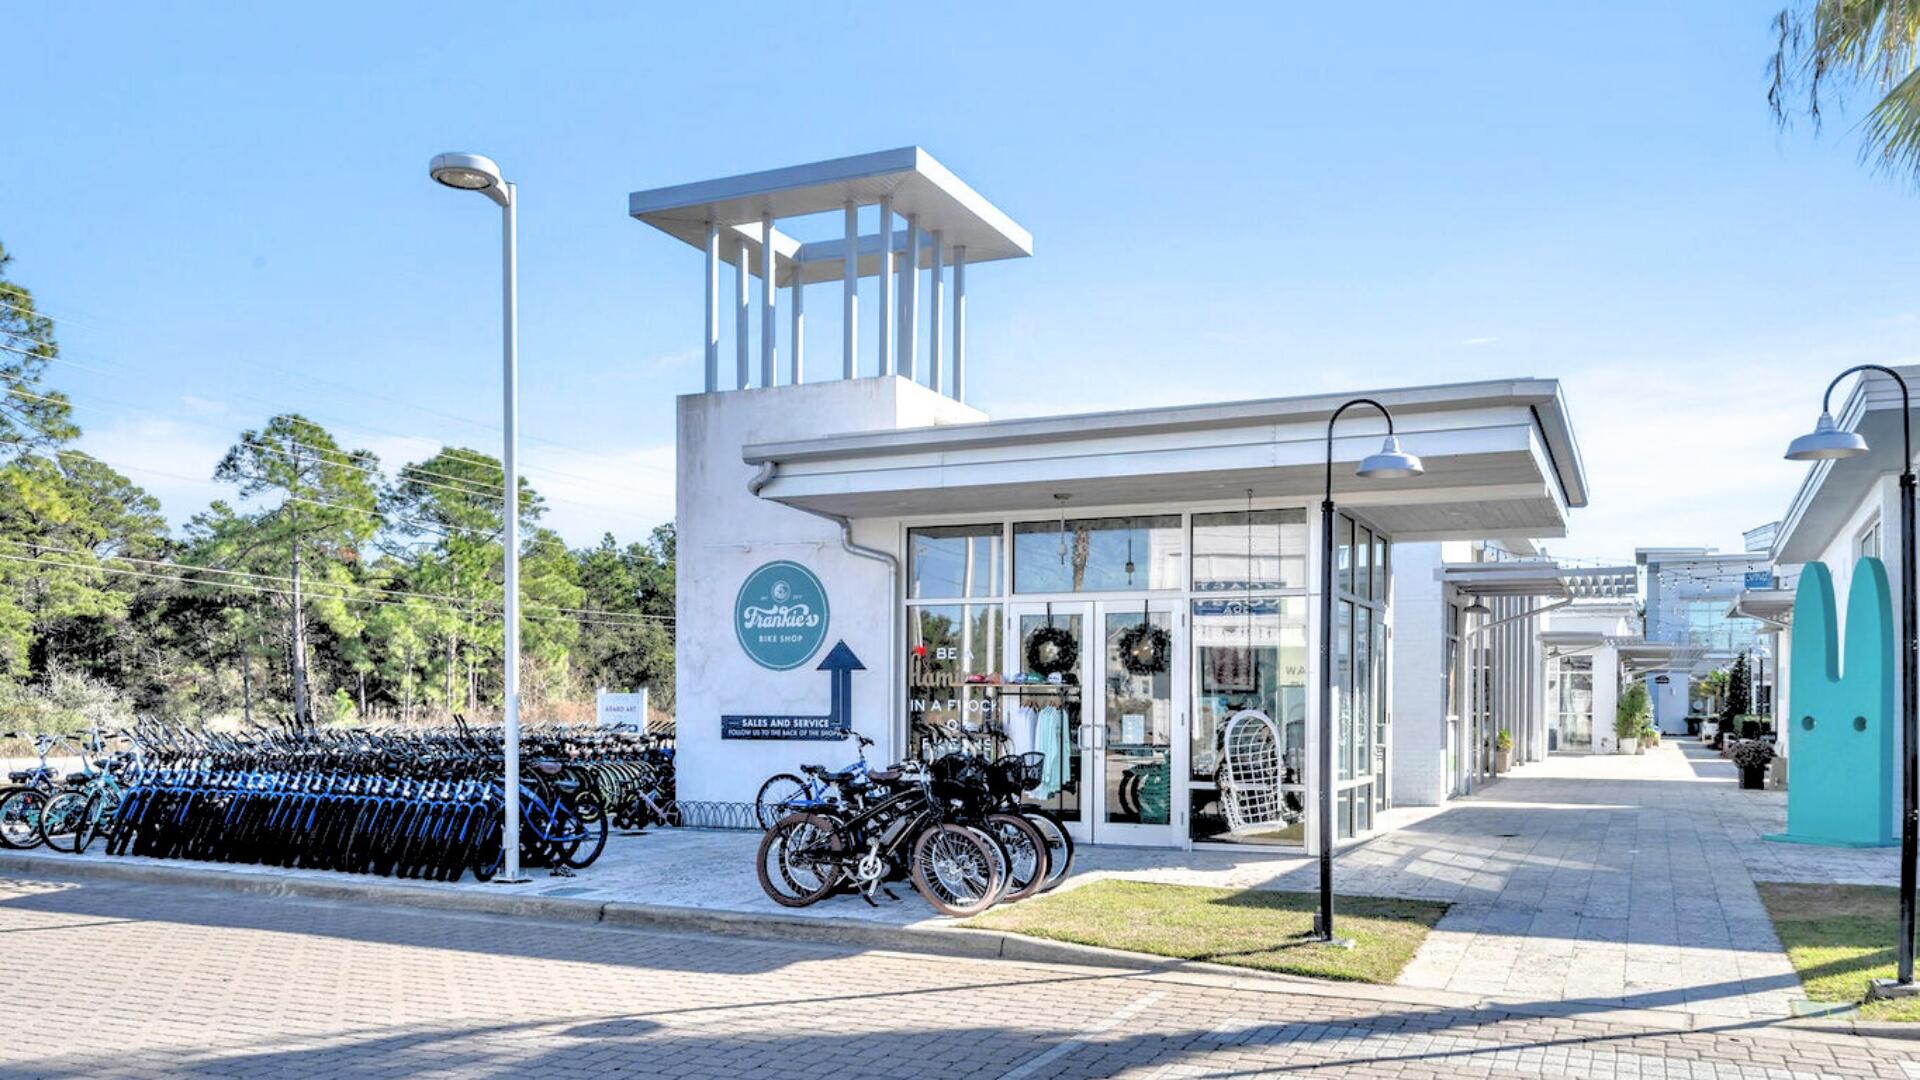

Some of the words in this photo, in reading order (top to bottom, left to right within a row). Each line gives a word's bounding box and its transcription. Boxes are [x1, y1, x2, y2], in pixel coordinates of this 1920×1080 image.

[744, 604, 819, 629] Frankie's
[937, 647, 957, 659] BE
[910, 700, 925, 712] IN
[931, 700, 942, 712] A
[742, 719, 768, 727] SALES
[770, 719, 790, 727] AND
[792, 719, 829, 727] SERVICE
